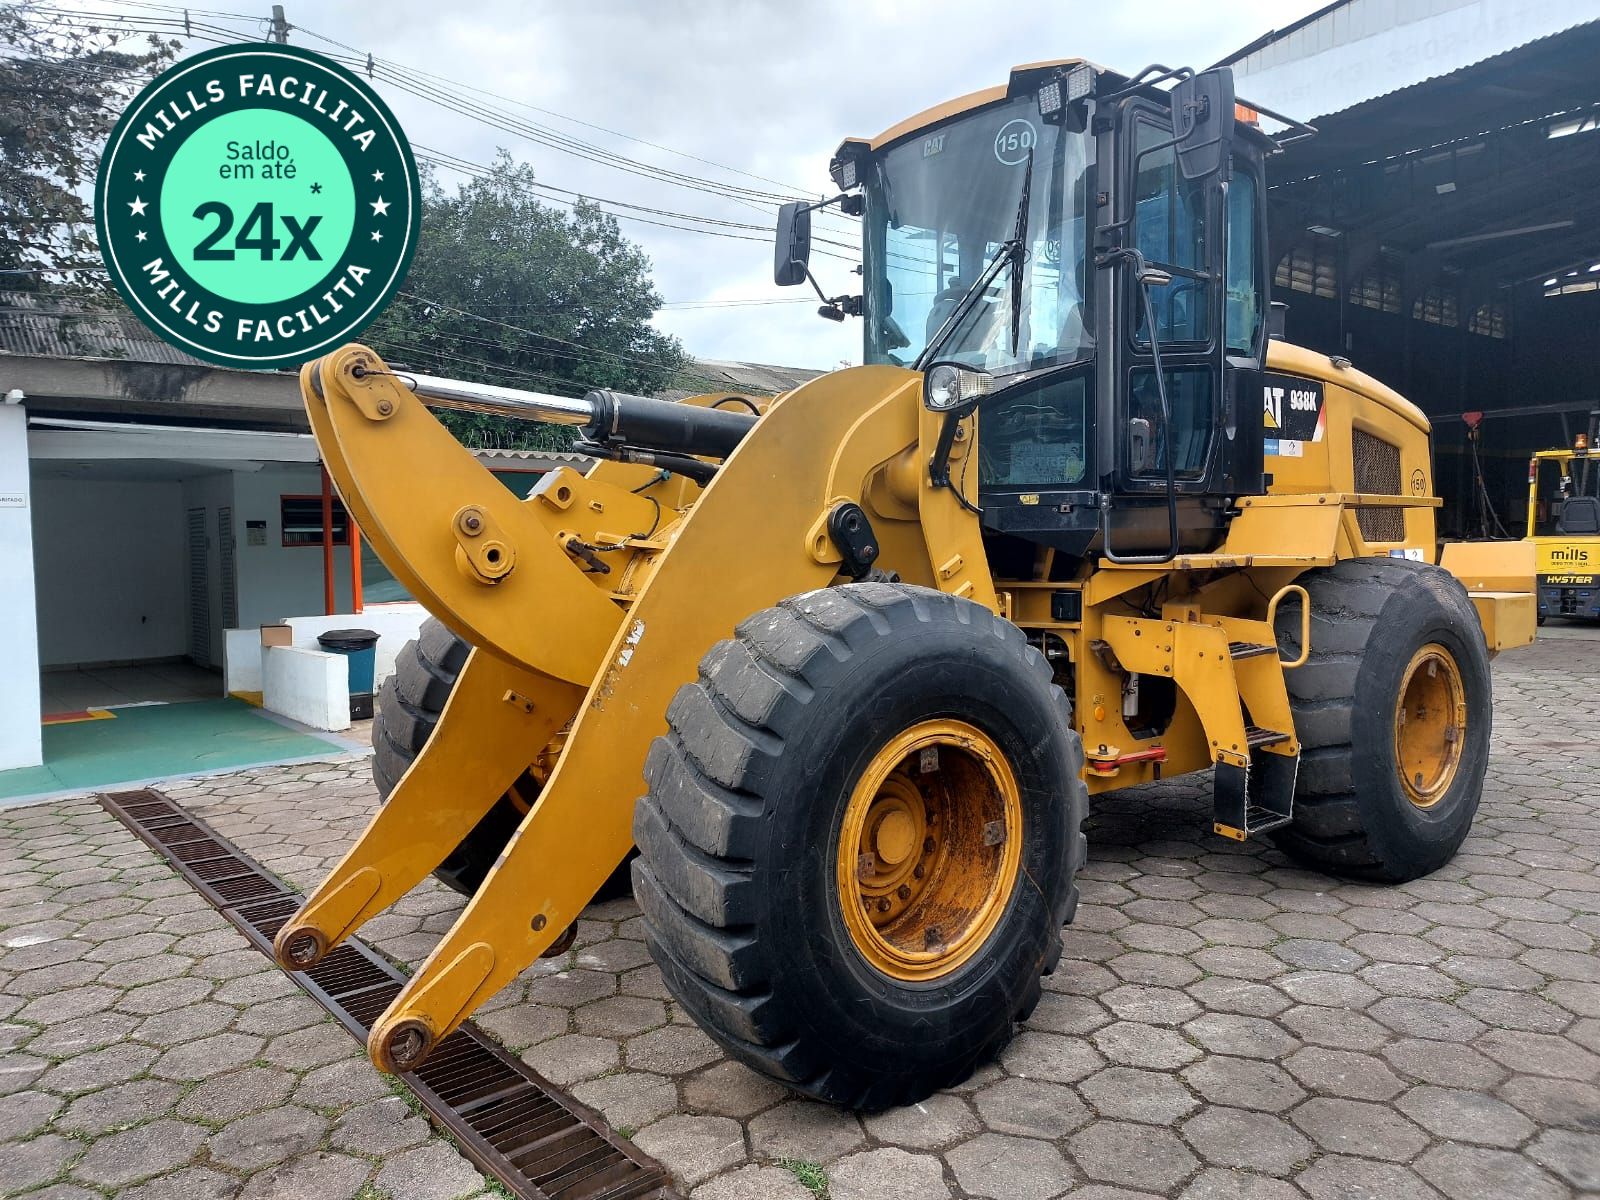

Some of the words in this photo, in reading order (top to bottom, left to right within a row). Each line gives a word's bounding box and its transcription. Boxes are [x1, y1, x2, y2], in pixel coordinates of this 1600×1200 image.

[923, 135, 947, 158] CAT
[999, 131, 1031, 153] 150
[1263, 386, 1285, 429] AT
[1290, 389, 1317, 412] 938K
[1412, 478, 1424, 490] 150
[1551, 546, 1588, 561] mills
